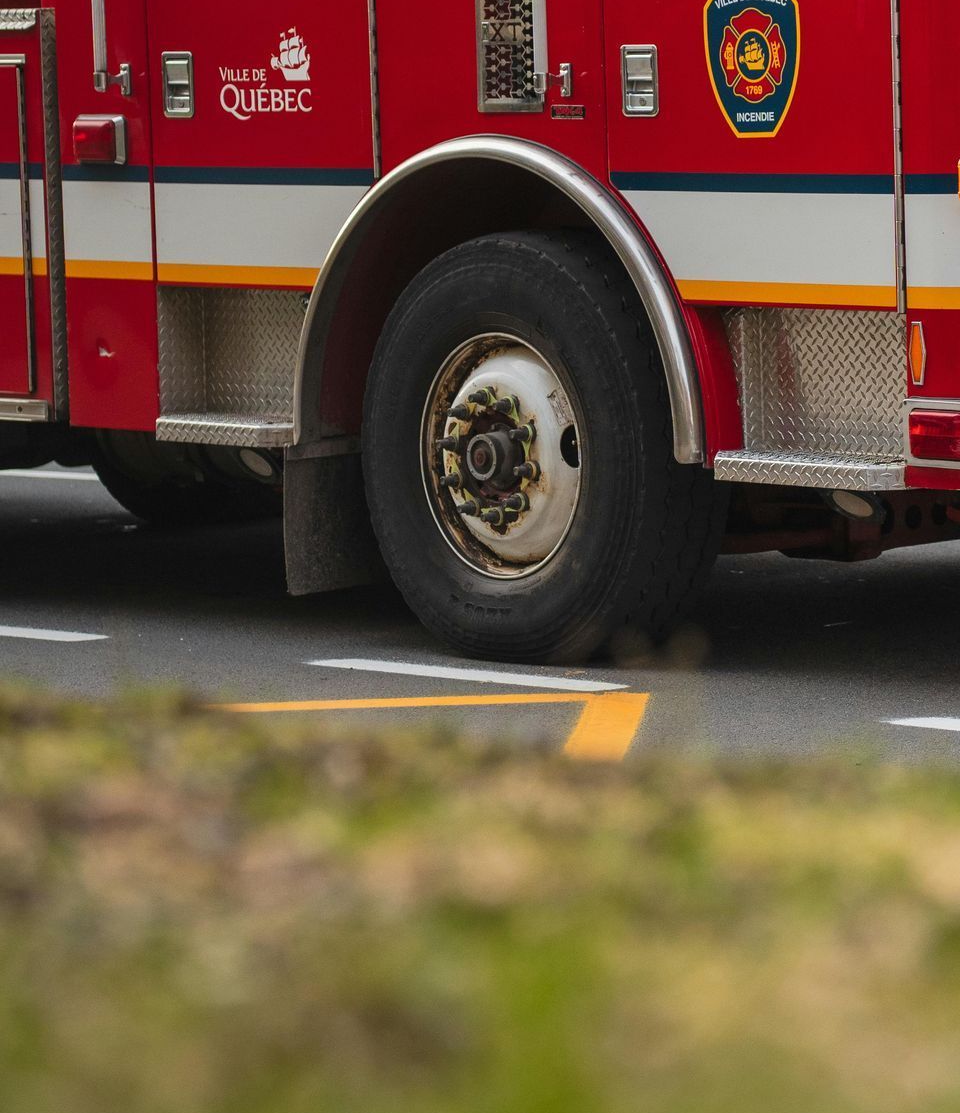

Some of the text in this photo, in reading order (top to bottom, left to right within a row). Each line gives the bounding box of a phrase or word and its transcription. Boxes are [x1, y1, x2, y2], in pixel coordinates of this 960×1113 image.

[218, 66, 267, 82] VILLE DE
[745, 85, 763, 95] 1769
[219, 82, 313, 120] QUÉBEC
[736, 111, 775, 123] INCENDIE
